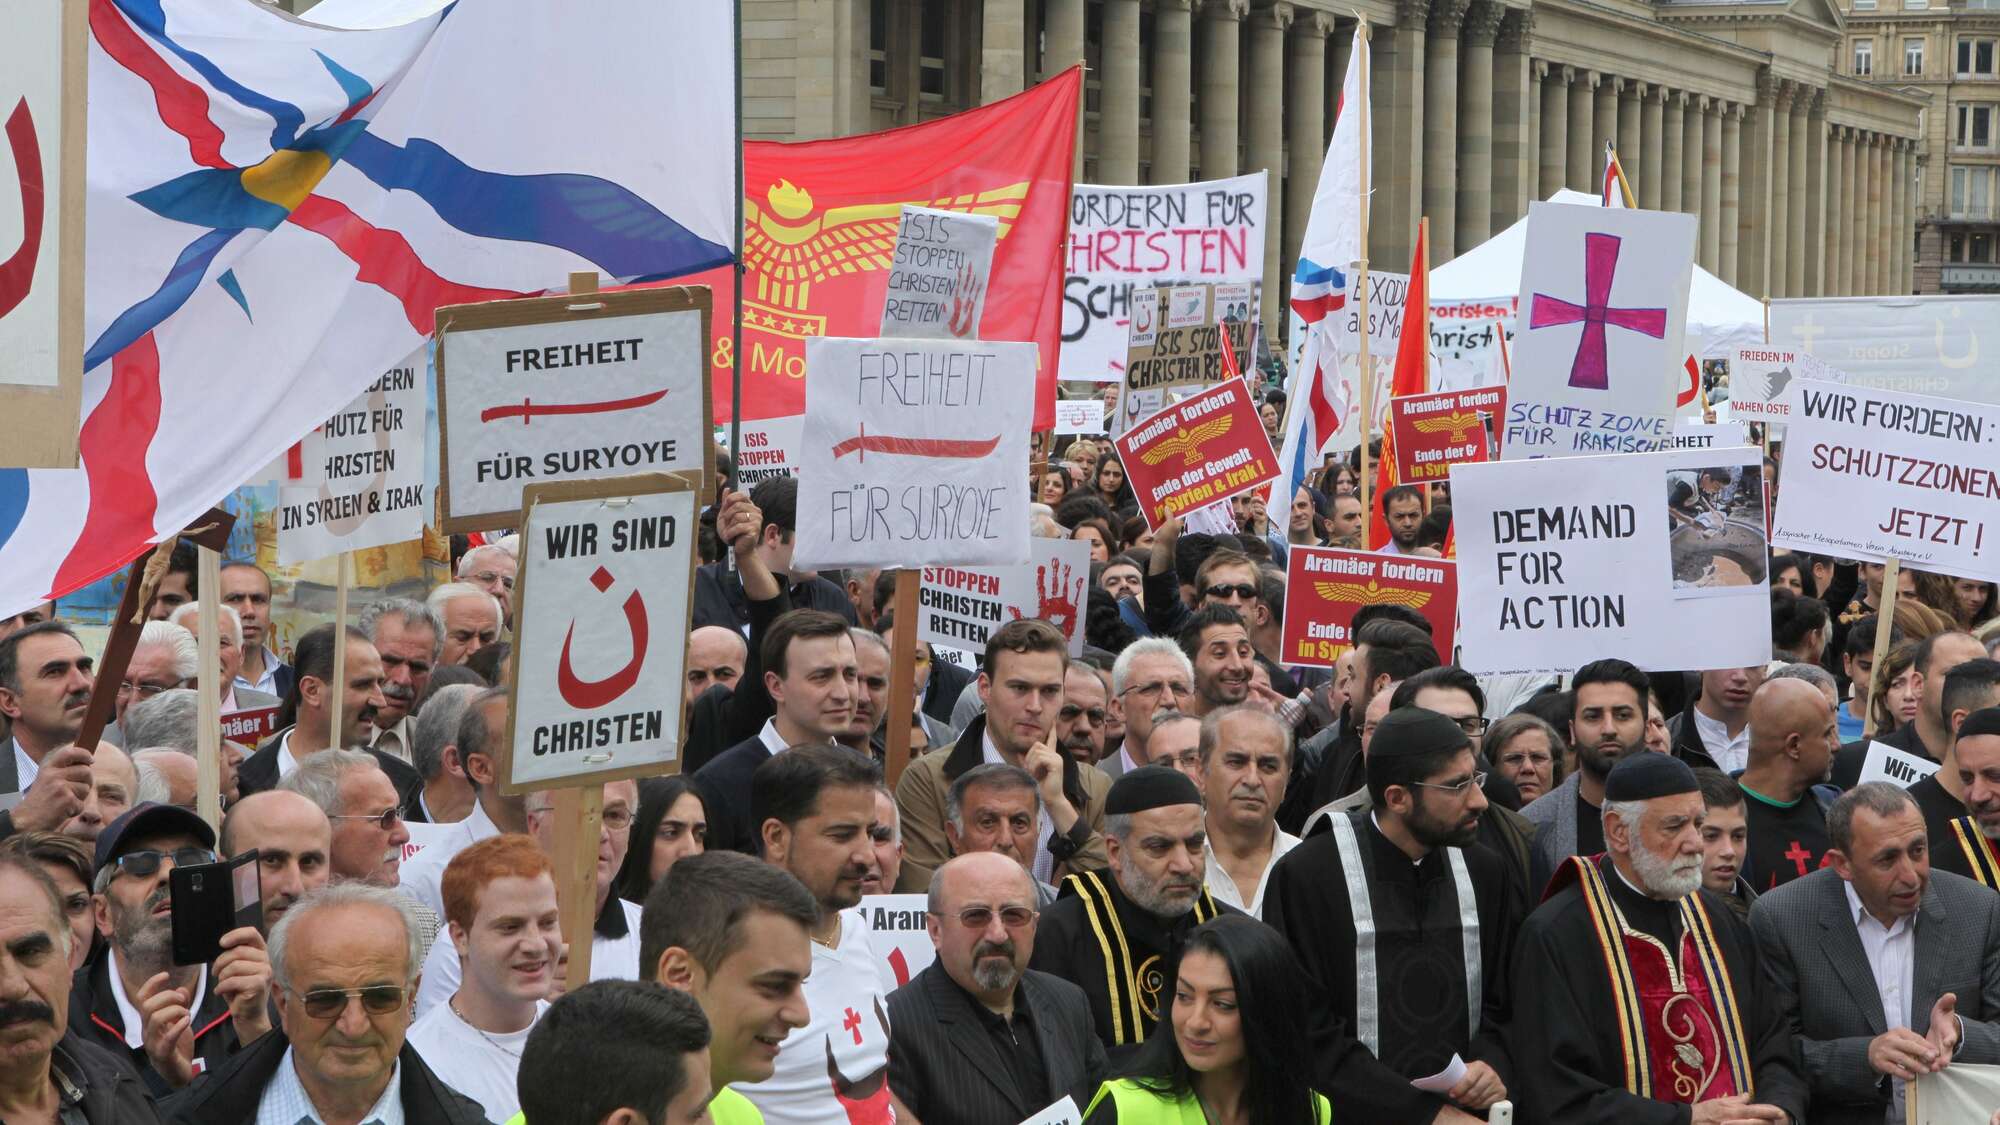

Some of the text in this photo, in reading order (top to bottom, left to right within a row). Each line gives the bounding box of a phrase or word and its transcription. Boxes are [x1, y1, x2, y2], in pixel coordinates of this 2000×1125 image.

[1206, 190, 1254, 227] FÜR
[899, 212, 950, 243] ISIS
[896, 242, 964, 270] STOPPEN
[1066, 228, 1246, 274] HRISTEN
[888, 271, 956, 296] CHRISTEN
[885, 299, 944, 323] RETTEN
[506, 338, 643, 373] FREIHEIT
[712, 336, 806, 378] & Mo
[1152, 329, 1184, 357] ISIS
[1740, 350, 1794, 363] FRIEDEN IM
[364, 367, 414, 393] DERN
[859, 352, 996, 406] FREIHEIT
[1127, 356, 1201, 390] CHRISTEN
[372, 403, 403, 432] FÜR
[1403, 392, 1499, 415] Aramäer fordern
[1730, 401, 1791, 415] NAHEN OSTE
[1803, 389, 1857, 424] WIR
[1862, 399, 1983, 444] FORDERN
[1127, 413, 1178, 453] Aramäer
[1180, 389, 1236, 422] fordern
[1508, 425, 1556, 445] FÜR
[744, 432, 768, 447] ISIS
[1414, 449, 1442, 462] Ende
[1444, 447, 1463, 459] der
[477, 440, 676, 483] FÜR SURYOYE
[738, 449, 785, 466] STOPPEN
[1410, 464, 1423, 478] in
[1811, 442, 2000, 500] SCHUTZZONEN
[1151, 447, 1253, 502] Ende der Gewalt
[1164, 487, 1214, 513] Syrien
[1213, 479, 1227, 493] &
[1225, 464, 1259, 488] Irak
[282, 484, 424, 531] IN SYRIEN & IRAK
[831, 483, 1006, 542] FÜR SURYOYE
[546, 515, 676, 560] WIR SIND
[1492, 504, 1636, 544] DEMAND
[1878, 507, 1968, 546] JETZT
[924, 566, 999, 596] STOPPEN
[1304, 554, 1444, 584] Aramäer fordern
[1497, 551, 1565, 586] FOR
[920, 587, 1002, 622] CHRISTEN
[1499, 594, 1625, 631] ACTION
[930, 614, 988, 645] RETTEN
[1307, 621, 1345, 640] Ende
[1298, 640, 1317, 657] in
[533, 710, 662, 756] CHRISTEN
[1884, 755, 1917, 783] Wir
